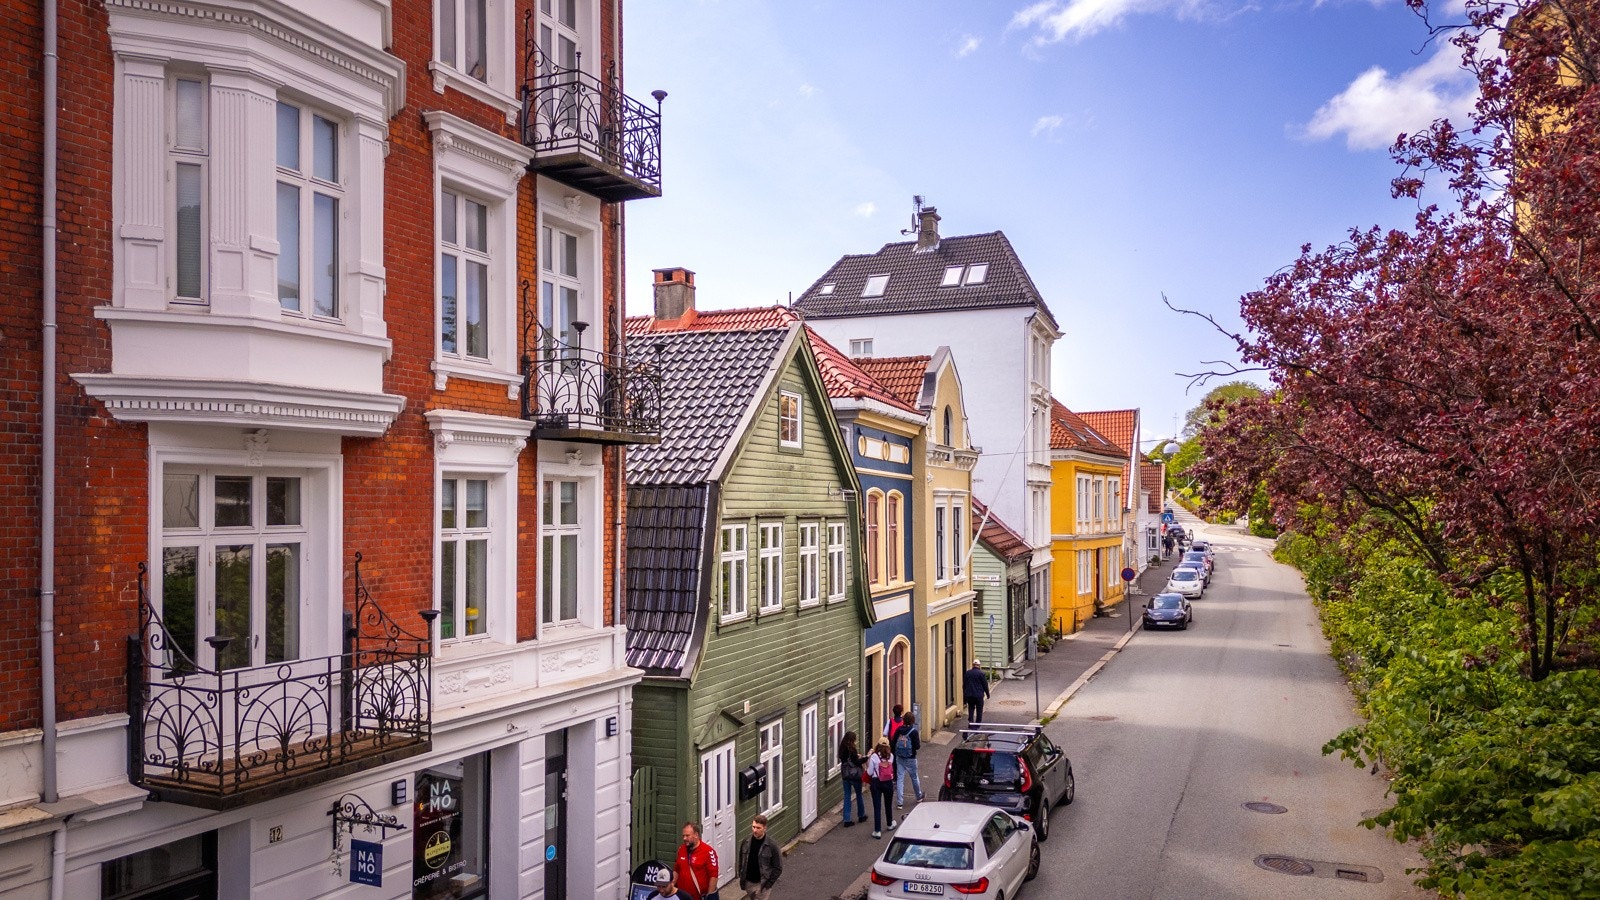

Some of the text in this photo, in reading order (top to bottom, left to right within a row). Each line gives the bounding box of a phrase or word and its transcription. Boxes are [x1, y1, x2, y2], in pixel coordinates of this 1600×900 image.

[430, 780, 452, 797] NA
[430, 795, 452, 813] MO
[272, 827, 281, 842] 12
[358, 850, 375, 863] NA
[358, 861, 375, 874] MO
[448, 859, 467, 873] BISTRO
[647, 865, 659, 875] NA
[909, 882, 942, 894] PD 68250
